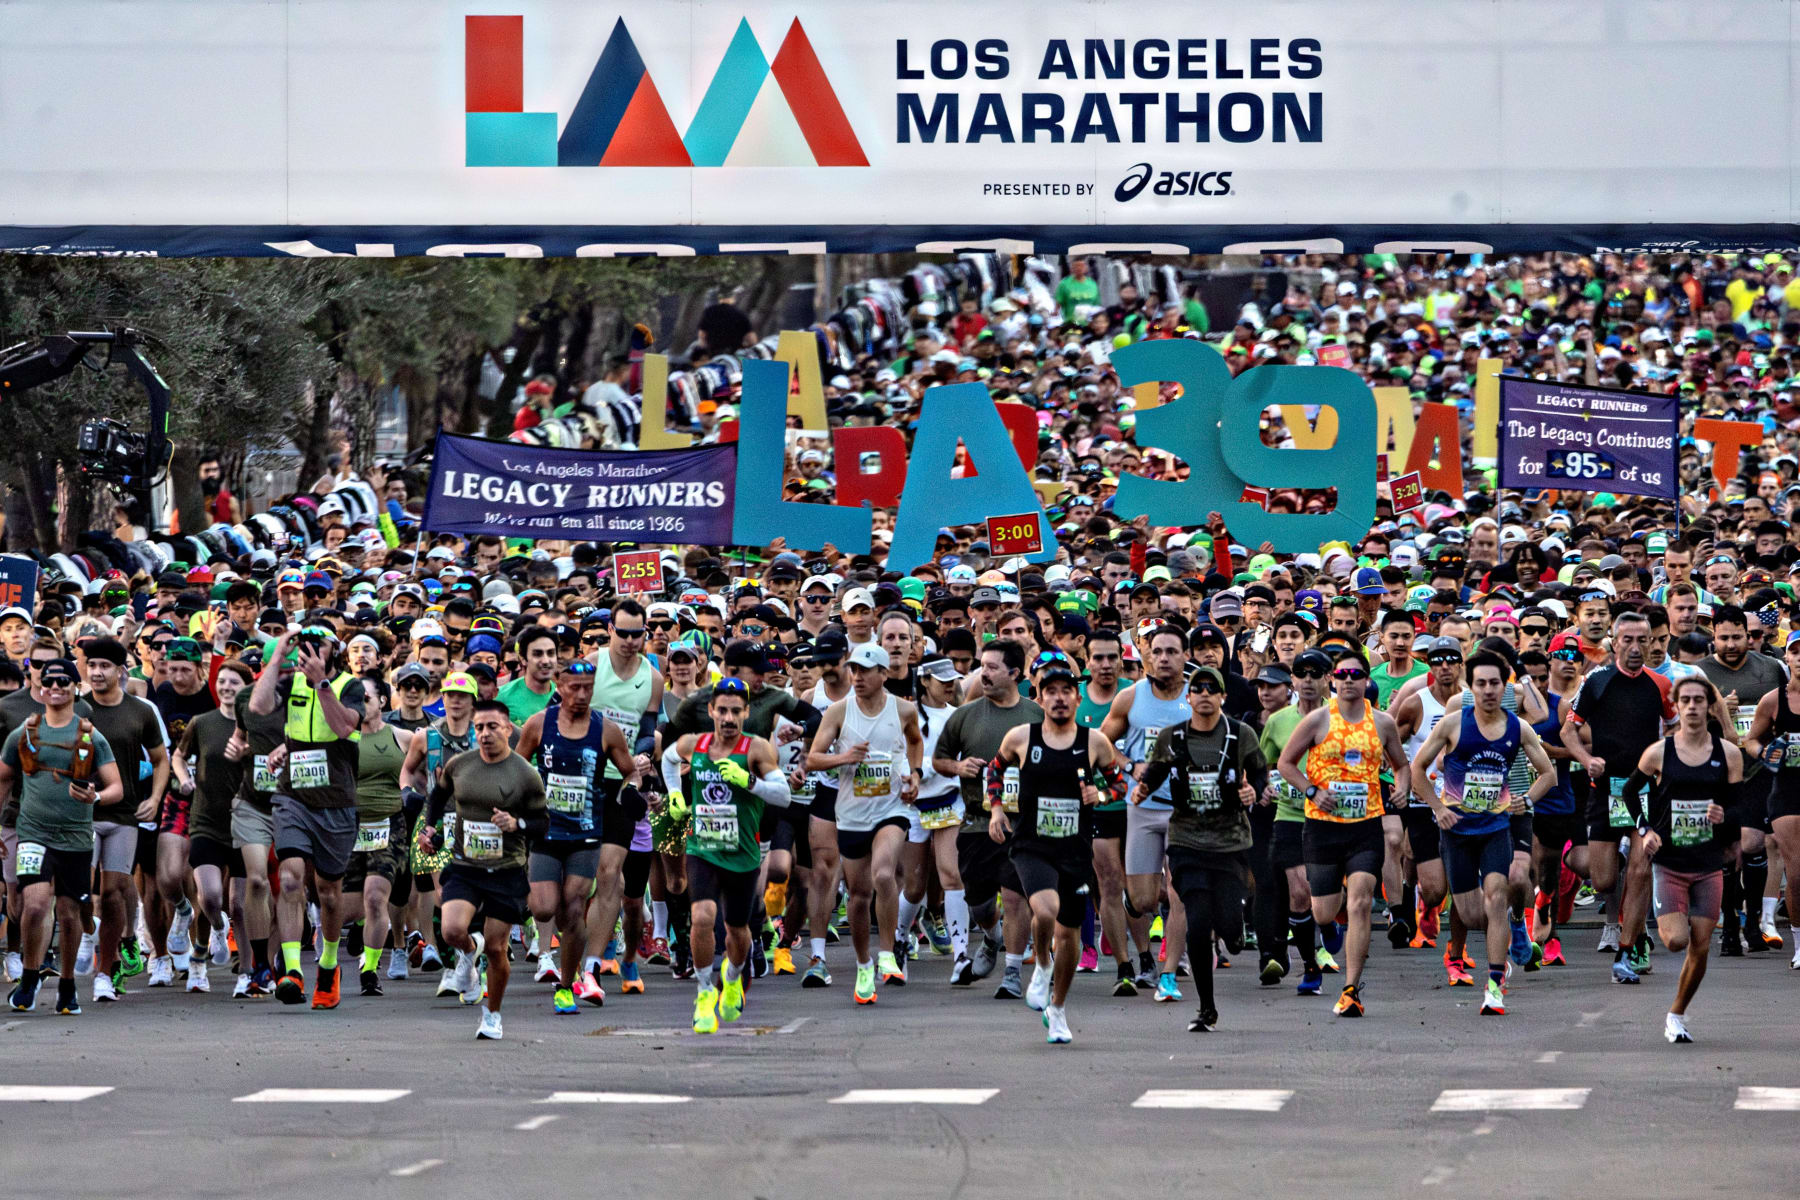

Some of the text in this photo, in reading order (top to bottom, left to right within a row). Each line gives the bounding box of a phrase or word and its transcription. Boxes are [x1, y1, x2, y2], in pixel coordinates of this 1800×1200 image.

[897, 38, 1323, 80] LOS ANGELES
[897, 92, 1323, 144] MARATHON
[983, 183, 1094, 196] PRESENTED BY
[1536, 395, 1586, 410] LEGACY
[1590, 399, 1648, 414] RUNNERS
[1507, 419, 1673, 450] The Legacy Continues
[1108, 338, 1378, 554] 39
[503, 459, 532, 473] Los
[535, 463, 594, 479] Angeles
[1518, 452, 1662, 486] for 95 of us
[442, 470, 726, 510] LEGACY RUNNERS
[1395, 482, 1418, 500] 3:20
[528, 517, 555, 529] run
[586, 514, 604, 530] all
[608, 517, 645, 531] since
[648, 516, 686, 533] 1986
[996, 523, 1034, 541] 3:00
[621, 561, 656, 579] 2:55
[293, 766, 325, 778] A1308
[547, 789, 583, 803] A1393
[1465, 789, 1499, 801] A1420
[700, 820, 735, 833] A1341
[466, 835, 500, 850] A1163
